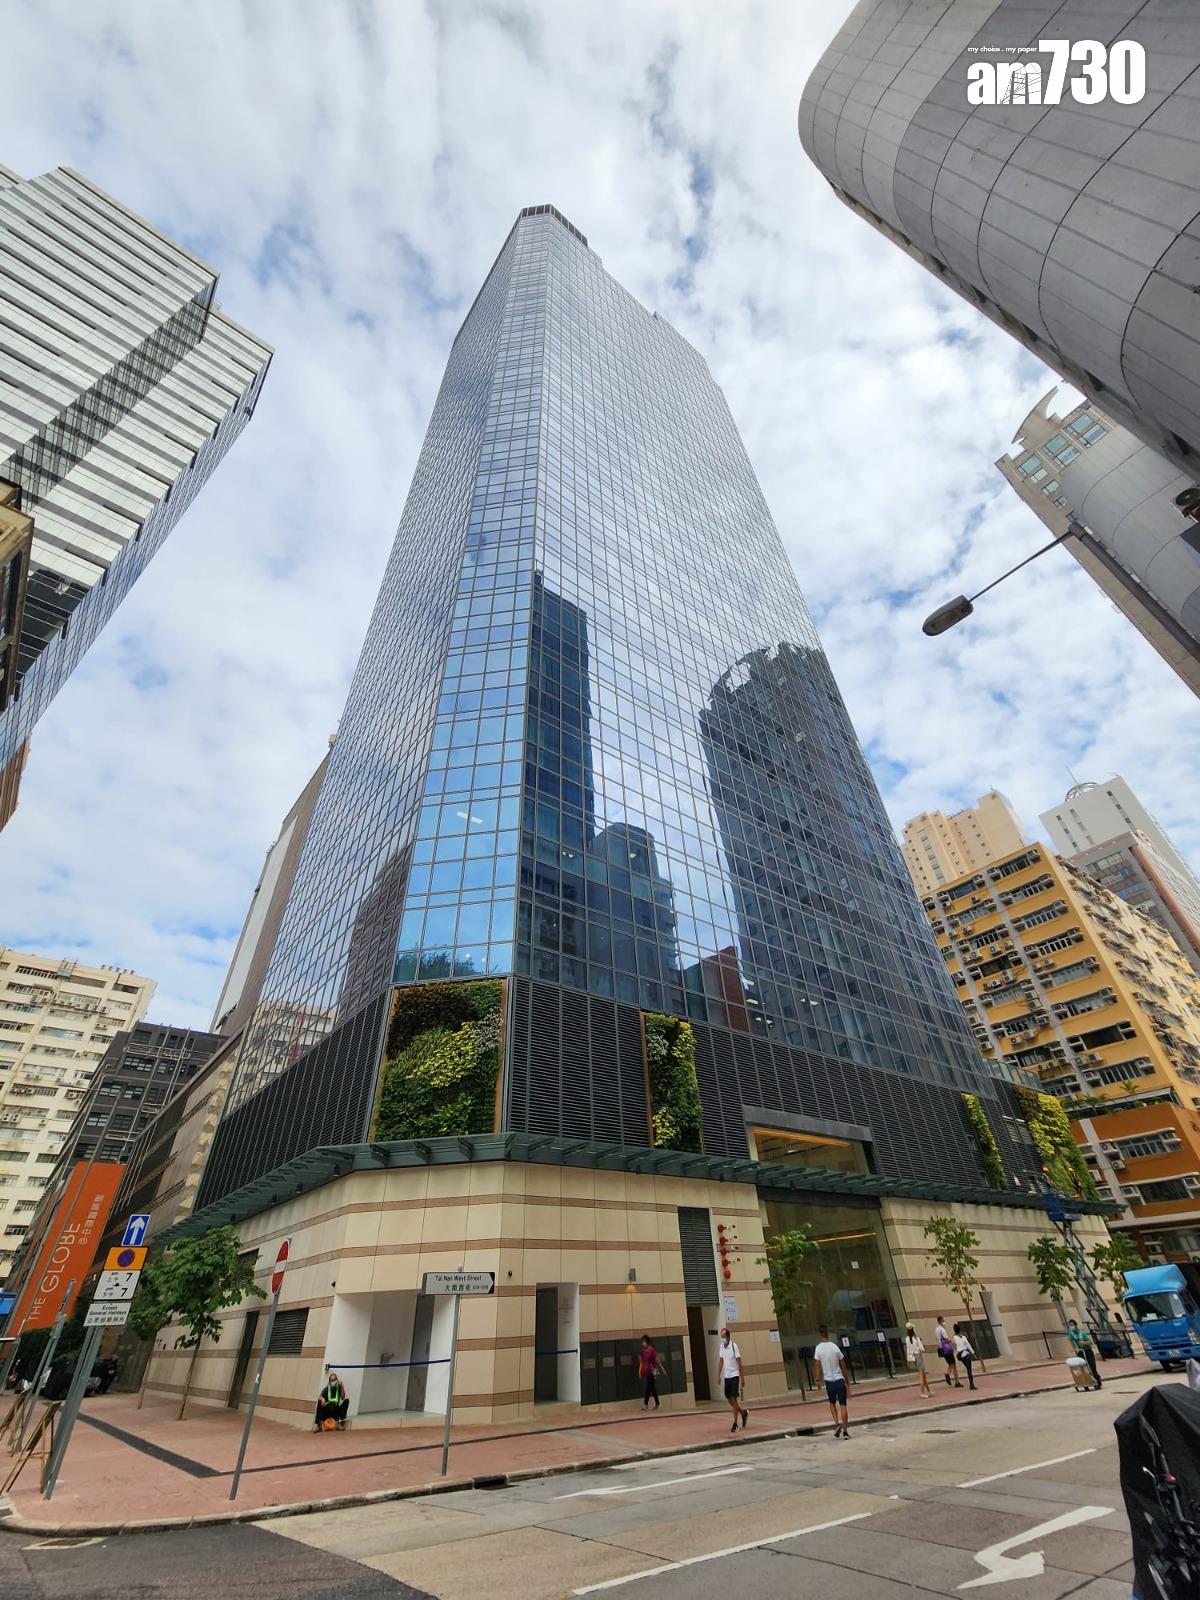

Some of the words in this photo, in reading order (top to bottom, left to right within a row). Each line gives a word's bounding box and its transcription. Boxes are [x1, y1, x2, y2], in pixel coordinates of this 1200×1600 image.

[27, 1297, 46, 1321] THE
[40, 1223, 81, 1293] GLOBE
[126, 1272, 133, 1282] 7
[120, 1287, 128, 1298] 7
